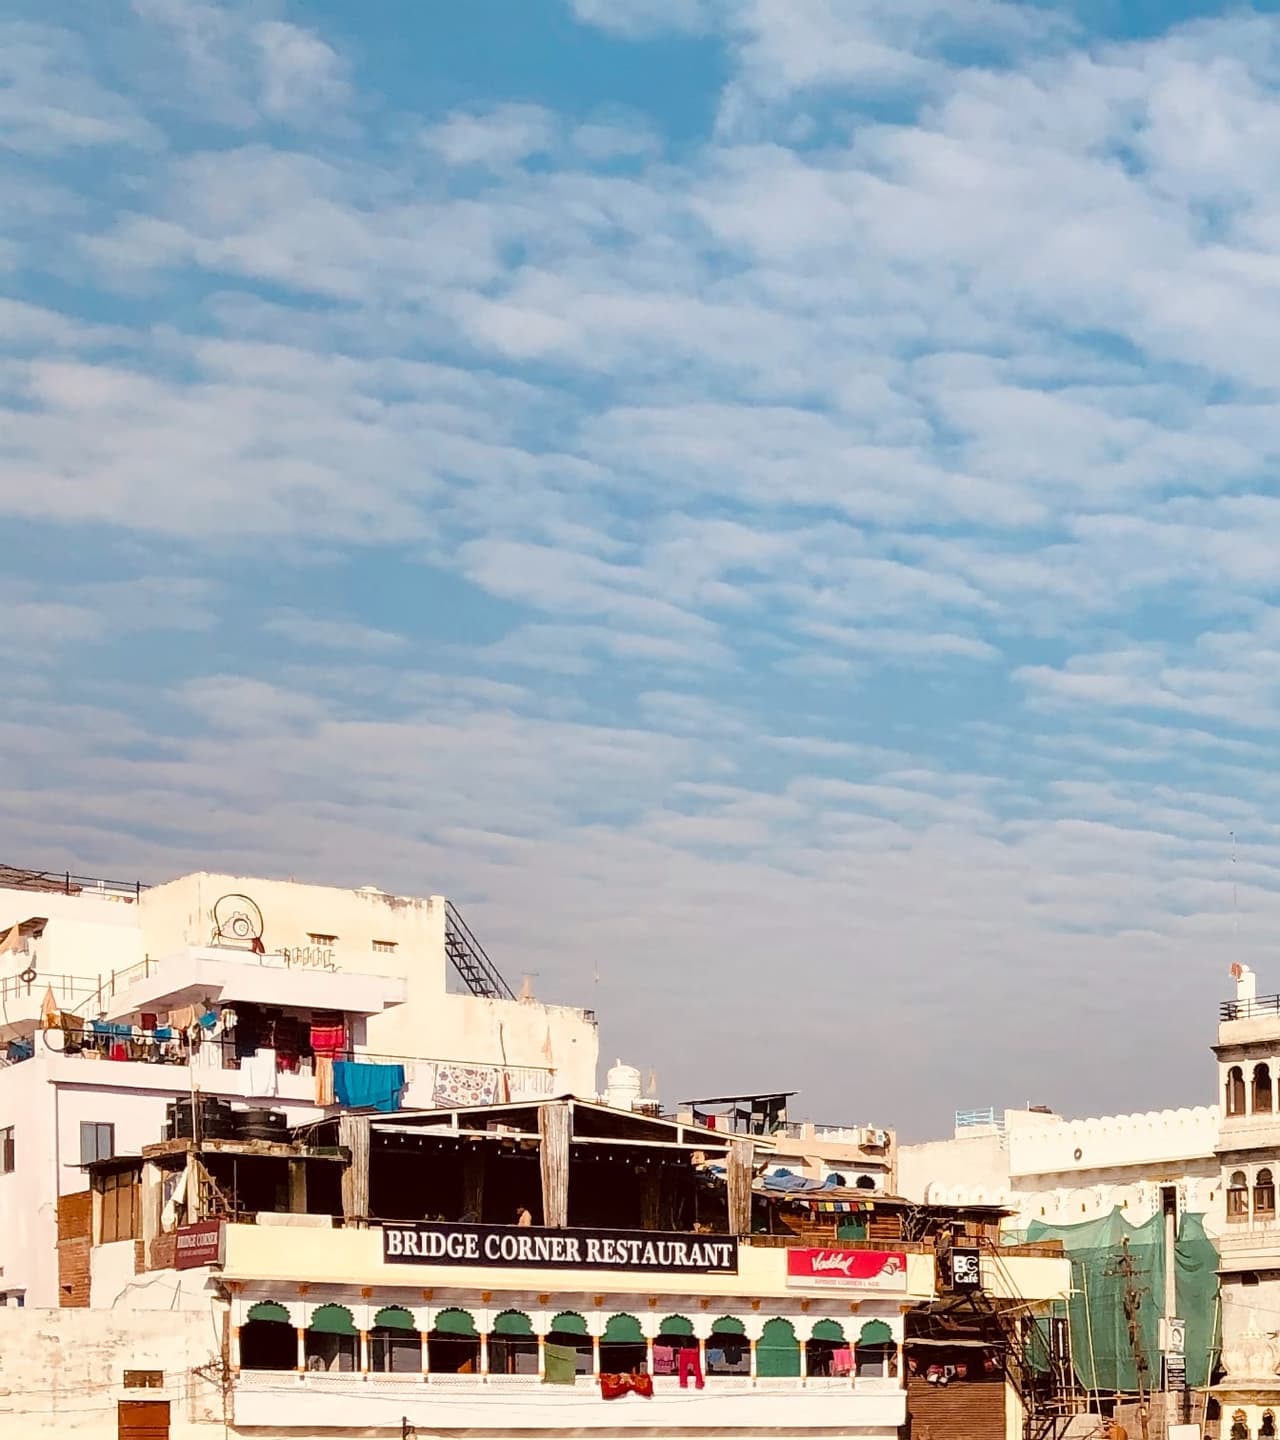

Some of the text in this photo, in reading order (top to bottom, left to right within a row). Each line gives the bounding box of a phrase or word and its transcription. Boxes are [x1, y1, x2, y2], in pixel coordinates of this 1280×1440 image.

[386, 1230, 733, 1267] BRIDGE CORNER RESTAURANT
